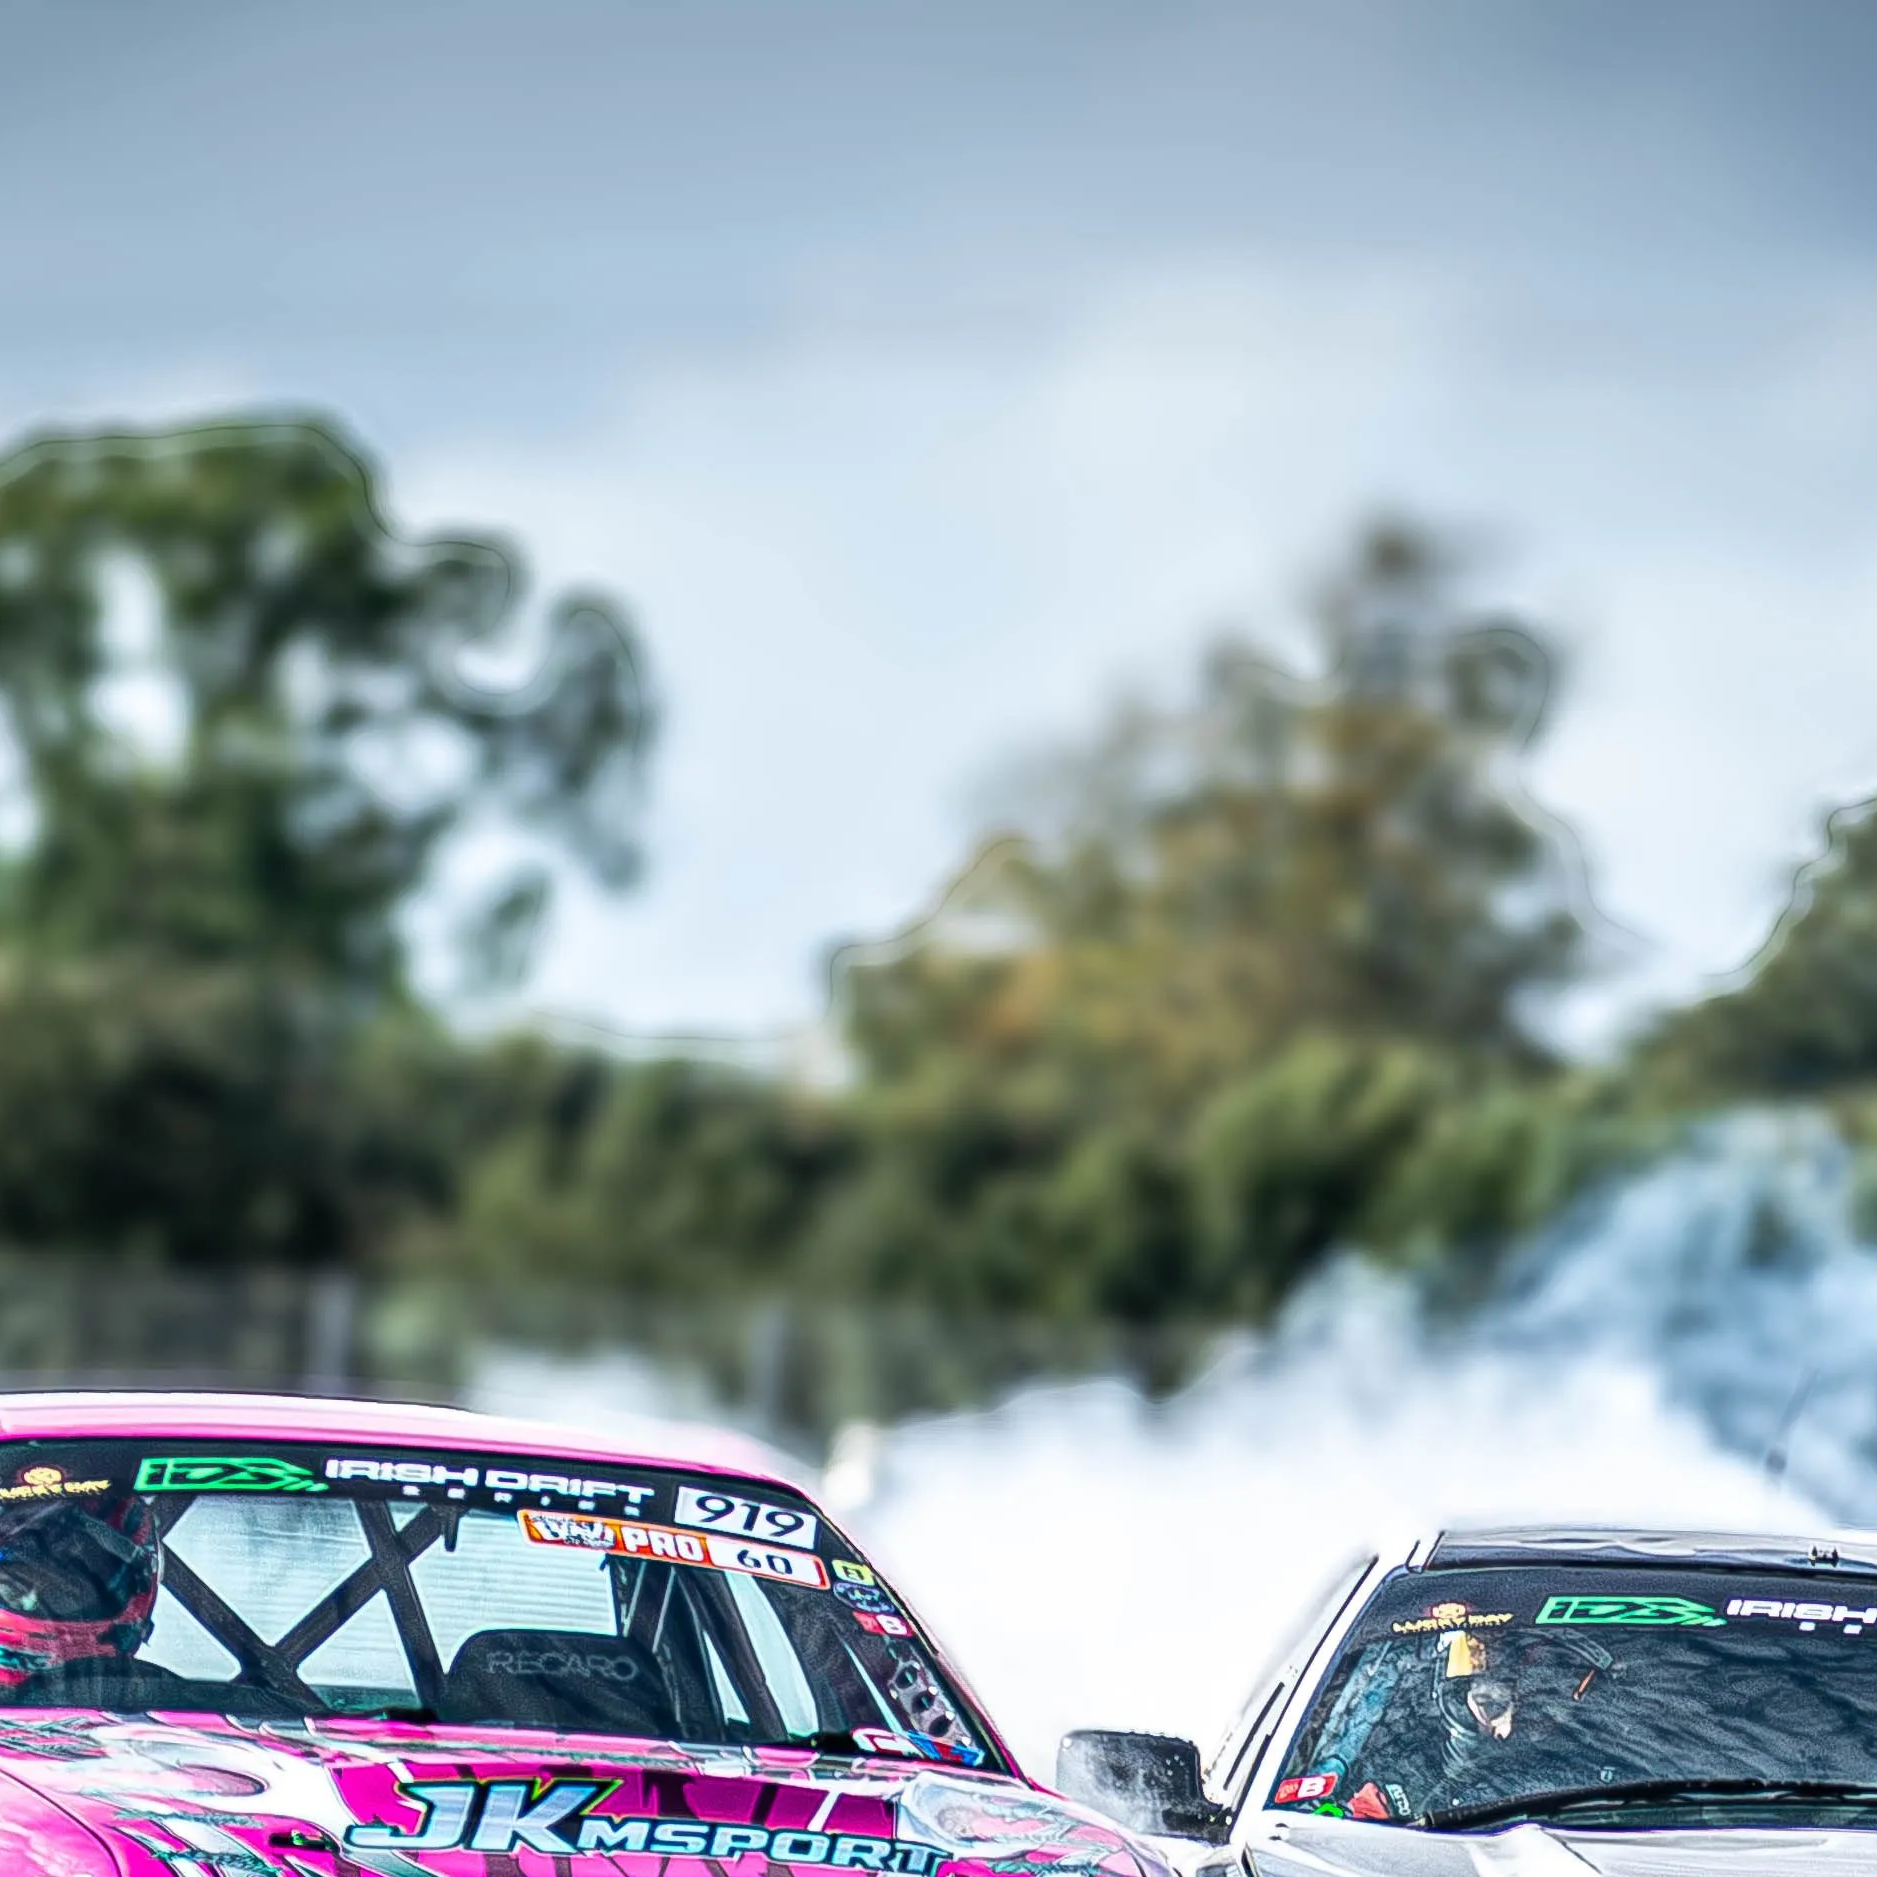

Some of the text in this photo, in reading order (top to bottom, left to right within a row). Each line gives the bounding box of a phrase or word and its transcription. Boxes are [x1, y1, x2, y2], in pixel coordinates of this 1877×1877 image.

[325, 1459, 655, 1504] IRISH DRIFT
[695, 1495, 805, 1537] 919
[620, 1525, 705, 1563] PRO
[736, 1549, 793, 1575] 60
[485, 1650, 640, 1682] RECARO
